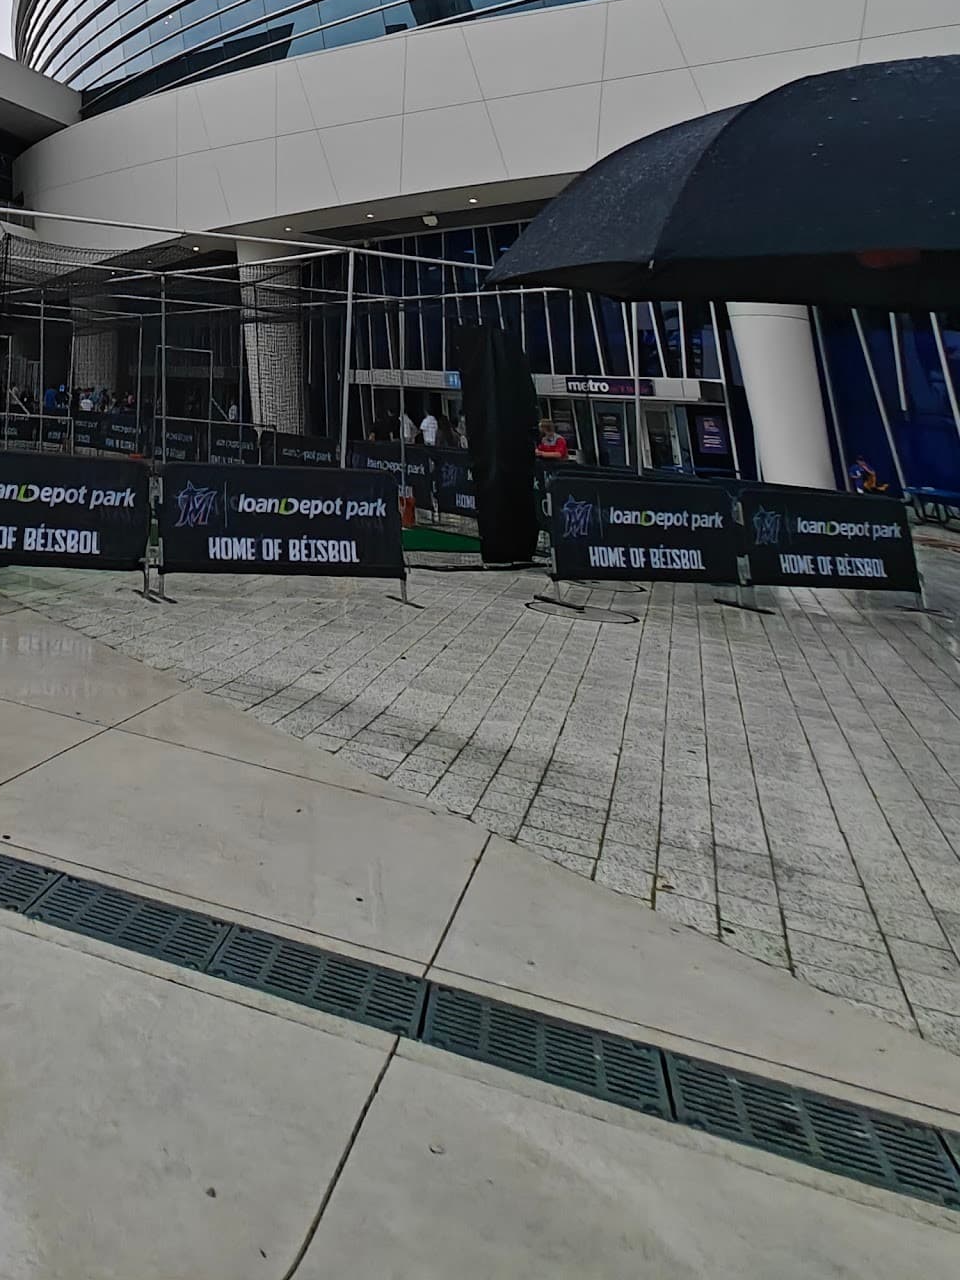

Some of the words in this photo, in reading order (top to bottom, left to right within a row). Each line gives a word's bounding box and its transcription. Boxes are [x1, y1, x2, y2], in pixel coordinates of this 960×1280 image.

[567, 379, 610, 393] metro
[89, 487, 136, 510] park
[237, 493, 342, 519] loanDepot
[345, 498, 387, 520] park
[609, 506, 689, 531] loanDepot
[691, 511, 724, 531] park
[797, 516, 870, 540] loanDepot
[872, 521, 902, 541] park
[23, 523, 101, 555] BÉISBOL
[208, 536, 256, 561] HOME
[262, 537, 283, 562] OF
[288, 534, 361, 564] BÉISBOL
[588, 545, 626, 569] HOME
[630, 547, 646, 569] OF
[649, 543, 706, 571] BÉISBOL
[779, 553, 815, 576] HOME
[818, 555, 834, 576] OF
